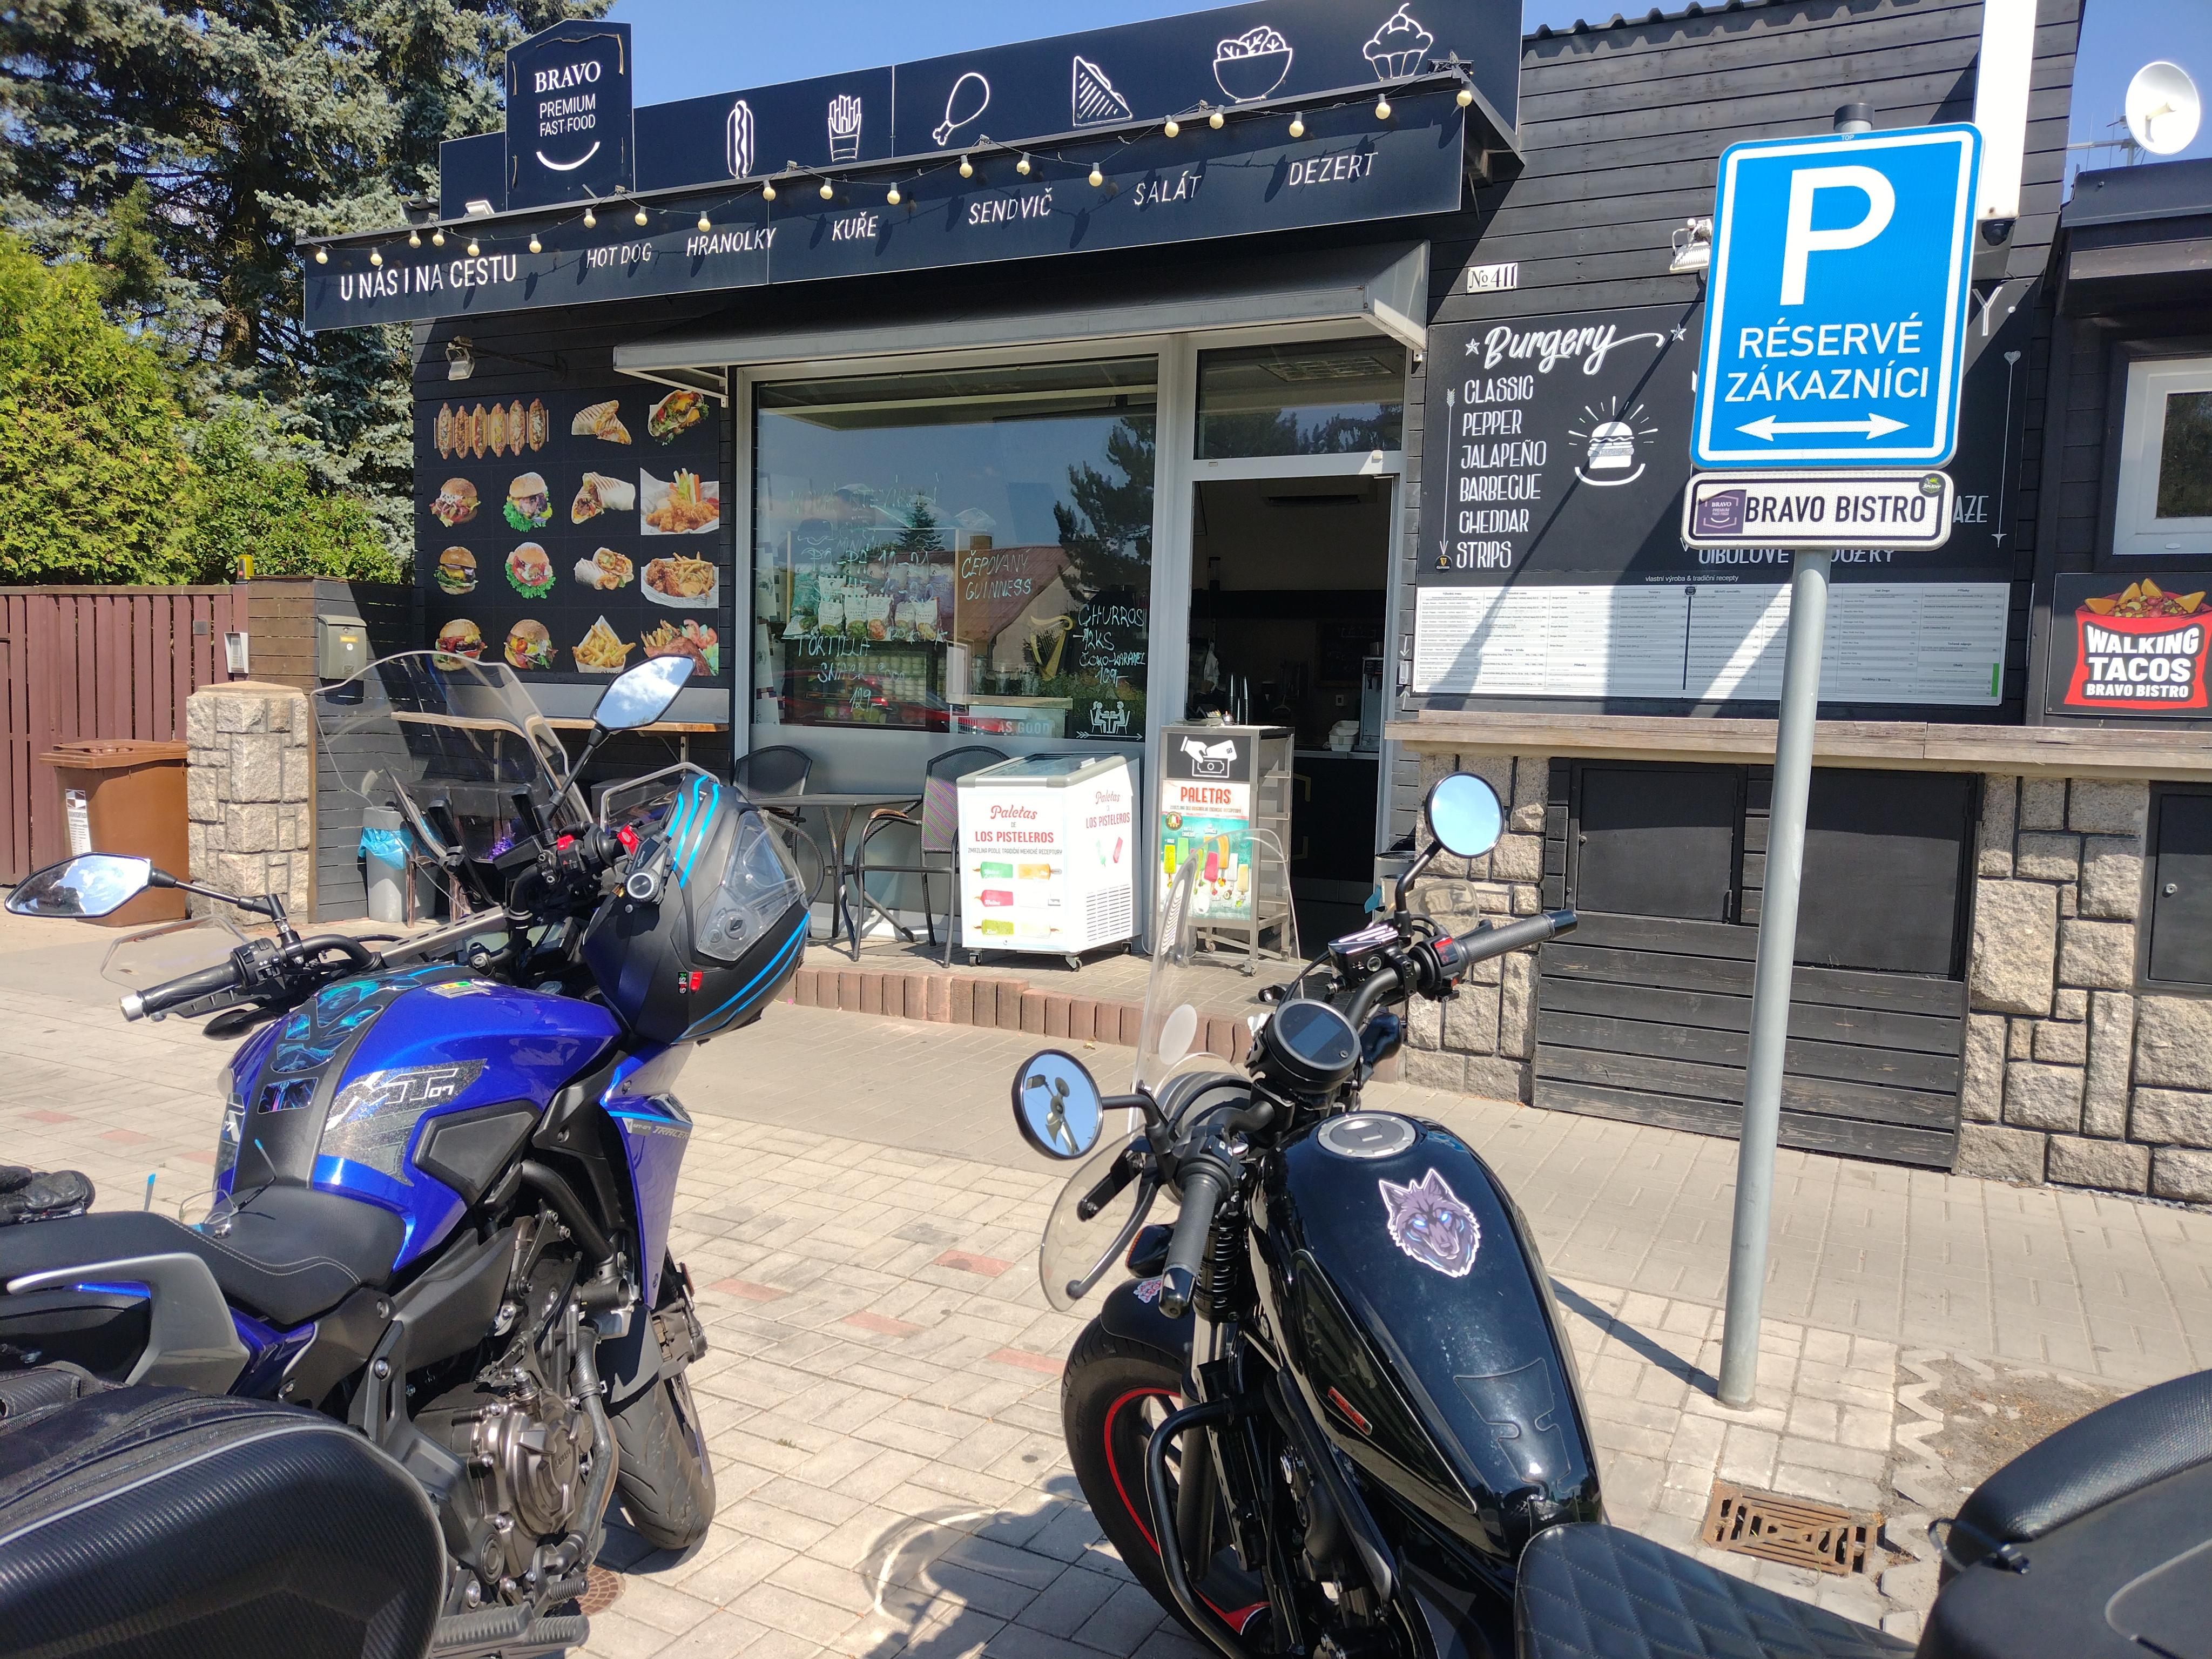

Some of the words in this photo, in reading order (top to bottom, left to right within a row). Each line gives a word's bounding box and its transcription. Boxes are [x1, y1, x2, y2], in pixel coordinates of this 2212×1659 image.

[535, 61, 601, 93] BRAVO
[539, 93, 596, 119] PREMIUM
[540, 119, 564, 137] FAST
[567, 114, 596, 132] FOOD
[1289, 151, 1379, 186] DEZERT
[1134, 170, 1202, 206] SALÁT
[968, 187, 1053, 226] SENDVIČ
[832, 212, 879, 241] KUŘE
[1780, 165, 1896, 306] P
[586, 246, 618, 268] HOT
[621, 242, 652, 265] DOG
[686, 227, 777, 257] HRANOLKY
[341, 275, 353, 301] U
[359, 265, 398, 299] NÁS
[404, 268, 409, 292] I
[415, 264, 444, 292] NA
[450, 254, 516, 288] CESTU
[1493, 266, 1514, 288] 411
[1738, 312, 1923, 359] RÉSERVÉ
[1483, 324, 1665, 375] Burgery
[1464, 375, 1534, 404] CLASSIC
[1724, 361, 1928, 402] ZÁKAZNÍCI
[1462, 409, 1522, 436] PEPPER
[1461, 440, 1547, 469] JALAPEÑO
[1460, 474, 1542, 502] BARBECUE
[1459, 509, 1529, 534] CHEDDAR
[1745, 496, 1825, 523] BRAVO
[1835, 496, 1925, 523] BISTRO
[961, 549, 1031, 579] ČEPOVANÝ
[1456, 541, 1512, 568] STRIPS
[966, 578, 1032, 601] GUINNESS
[1078, 604, 1144, 628] CHURROS
[794, 635, 870, 657] TORTILLA
[2087, 625, 2199, 655] WALKING
[2088, 657, 2191, 683] TACOS
[2086, 684, 2133, 697] BRAVO
[2136, 684, 2189, 698] BISTRO
[997, 721, 1013, 733] AS
[1017, 721, 1050, 734] GOOD
[1096, 790, 1120, 804] Paletas
[1181, 787, 1231, 805] PALETAS
[990, 804, 1037, 820] Paletas
[1086, 817, 1097, 828] LOS
[1099, 812, 1130, 827] PISTELEROS
[975, 831, 993, 842] LOS
[996, 831, 1054, 843] PISTELEROS
[652, 1125, 690, 1139] TRACER
